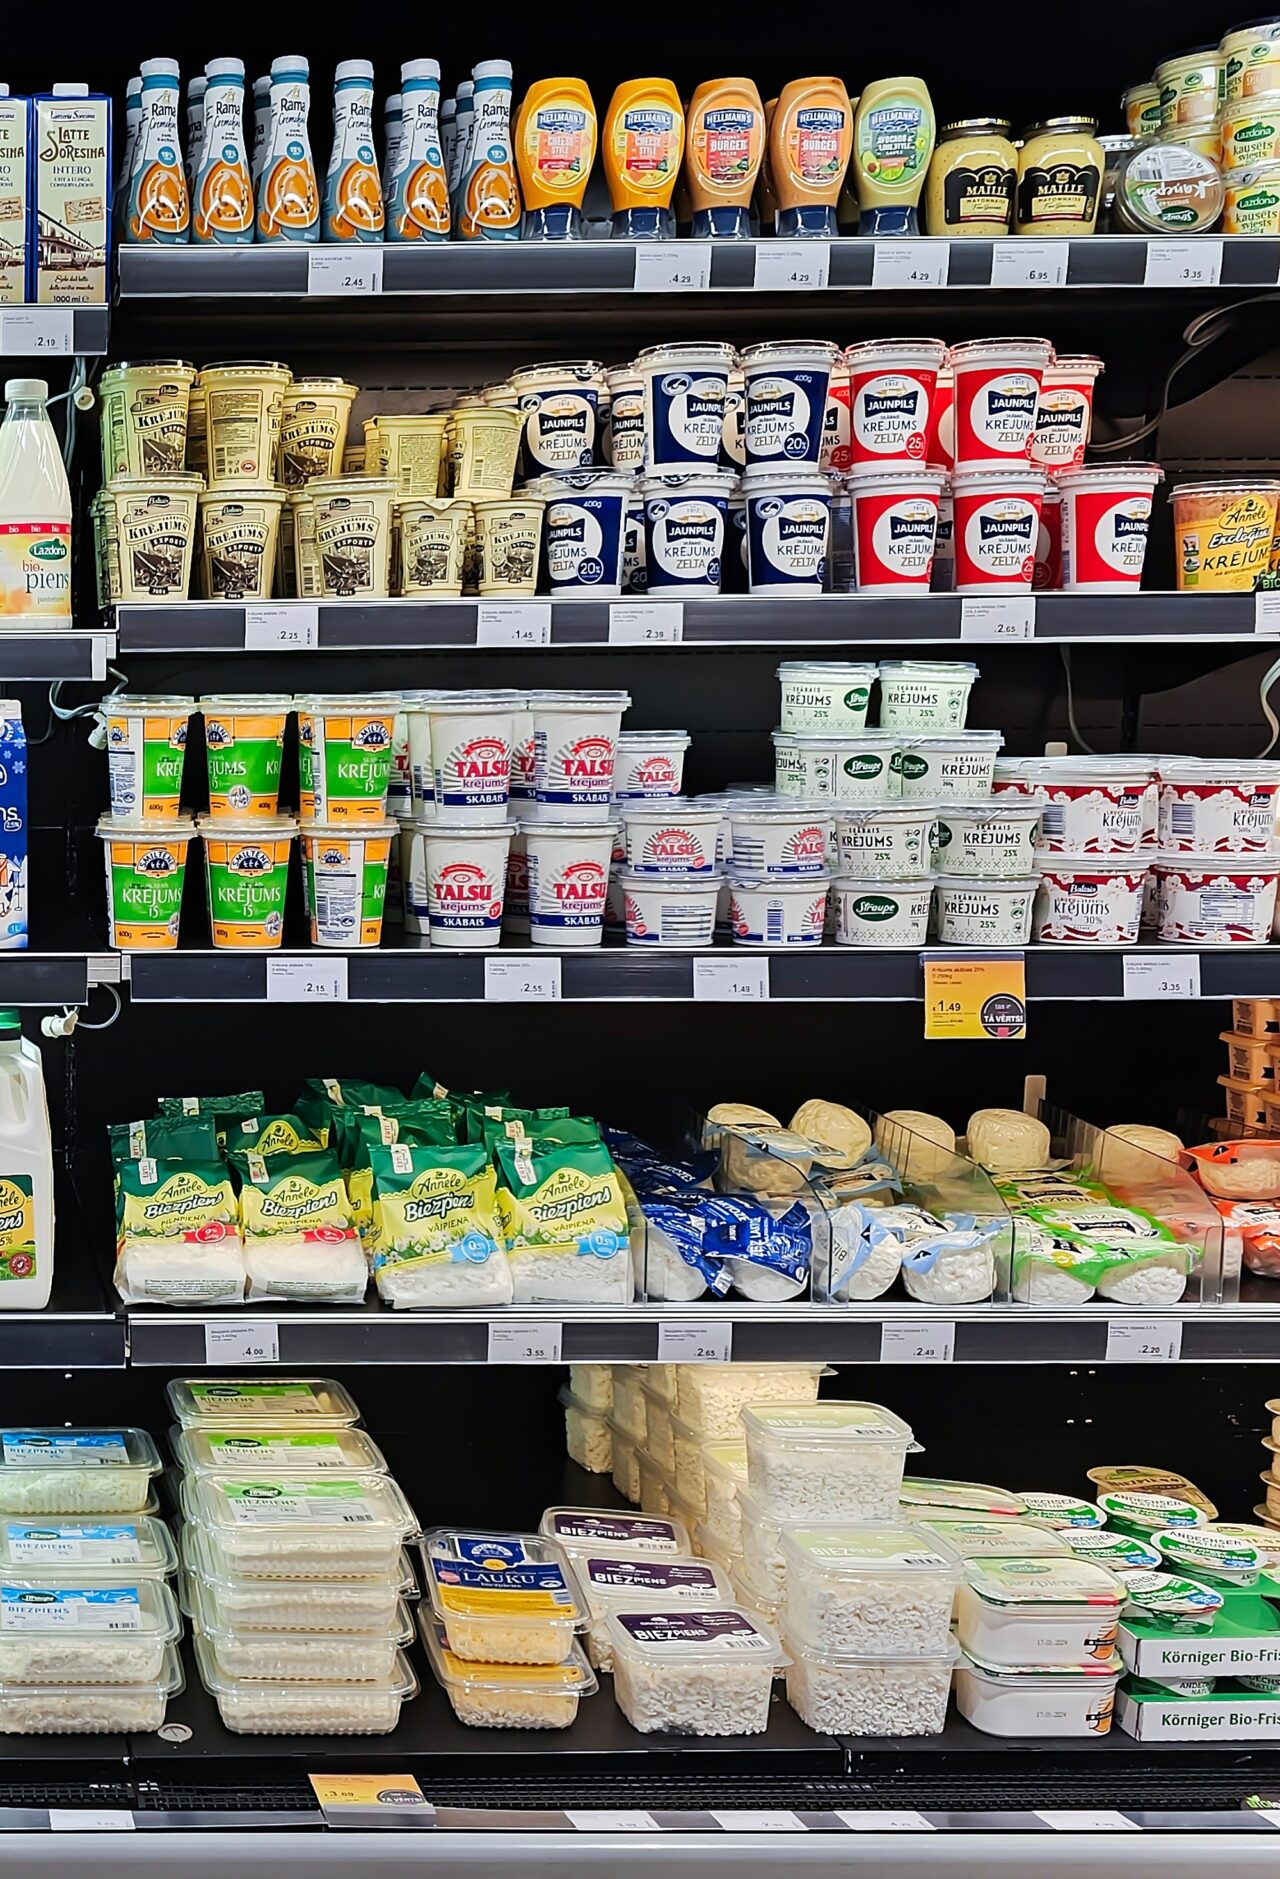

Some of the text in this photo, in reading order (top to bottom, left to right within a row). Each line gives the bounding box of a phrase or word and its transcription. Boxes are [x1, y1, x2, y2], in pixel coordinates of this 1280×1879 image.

[710, 140, 747, 151] BURGER
[53, 165, 92, 175] INTERO
[967, 184, 1008, 196] MAILLE
[1038, 183, 1084, 195] MAILLE
[749, 402, 791, 414] JAUNPILS
[867, 398, 914, 412] JAUNPILS
[541, 416, 585, 430] JAUNPILS
[754, 435, 781, 447] ZELTA
[874, 432, 905, 445] ZELTA
[669, 525, 714, 537] JAUNPILS
[984, 522, 1030, 535] JAUNPILS
[676, 558, 705, 570] ZELTA
[991, 555, 1021, 567] ZELTA
[455, 761, 510, 778] TALSU
[434, 884, 492, 901] TALSU
[463, 1571, 535, 1585] LAUKU
[1161, 1650, 1225, 1665] Körniger
[1161, 1713, 1224, 1729] Körniger
